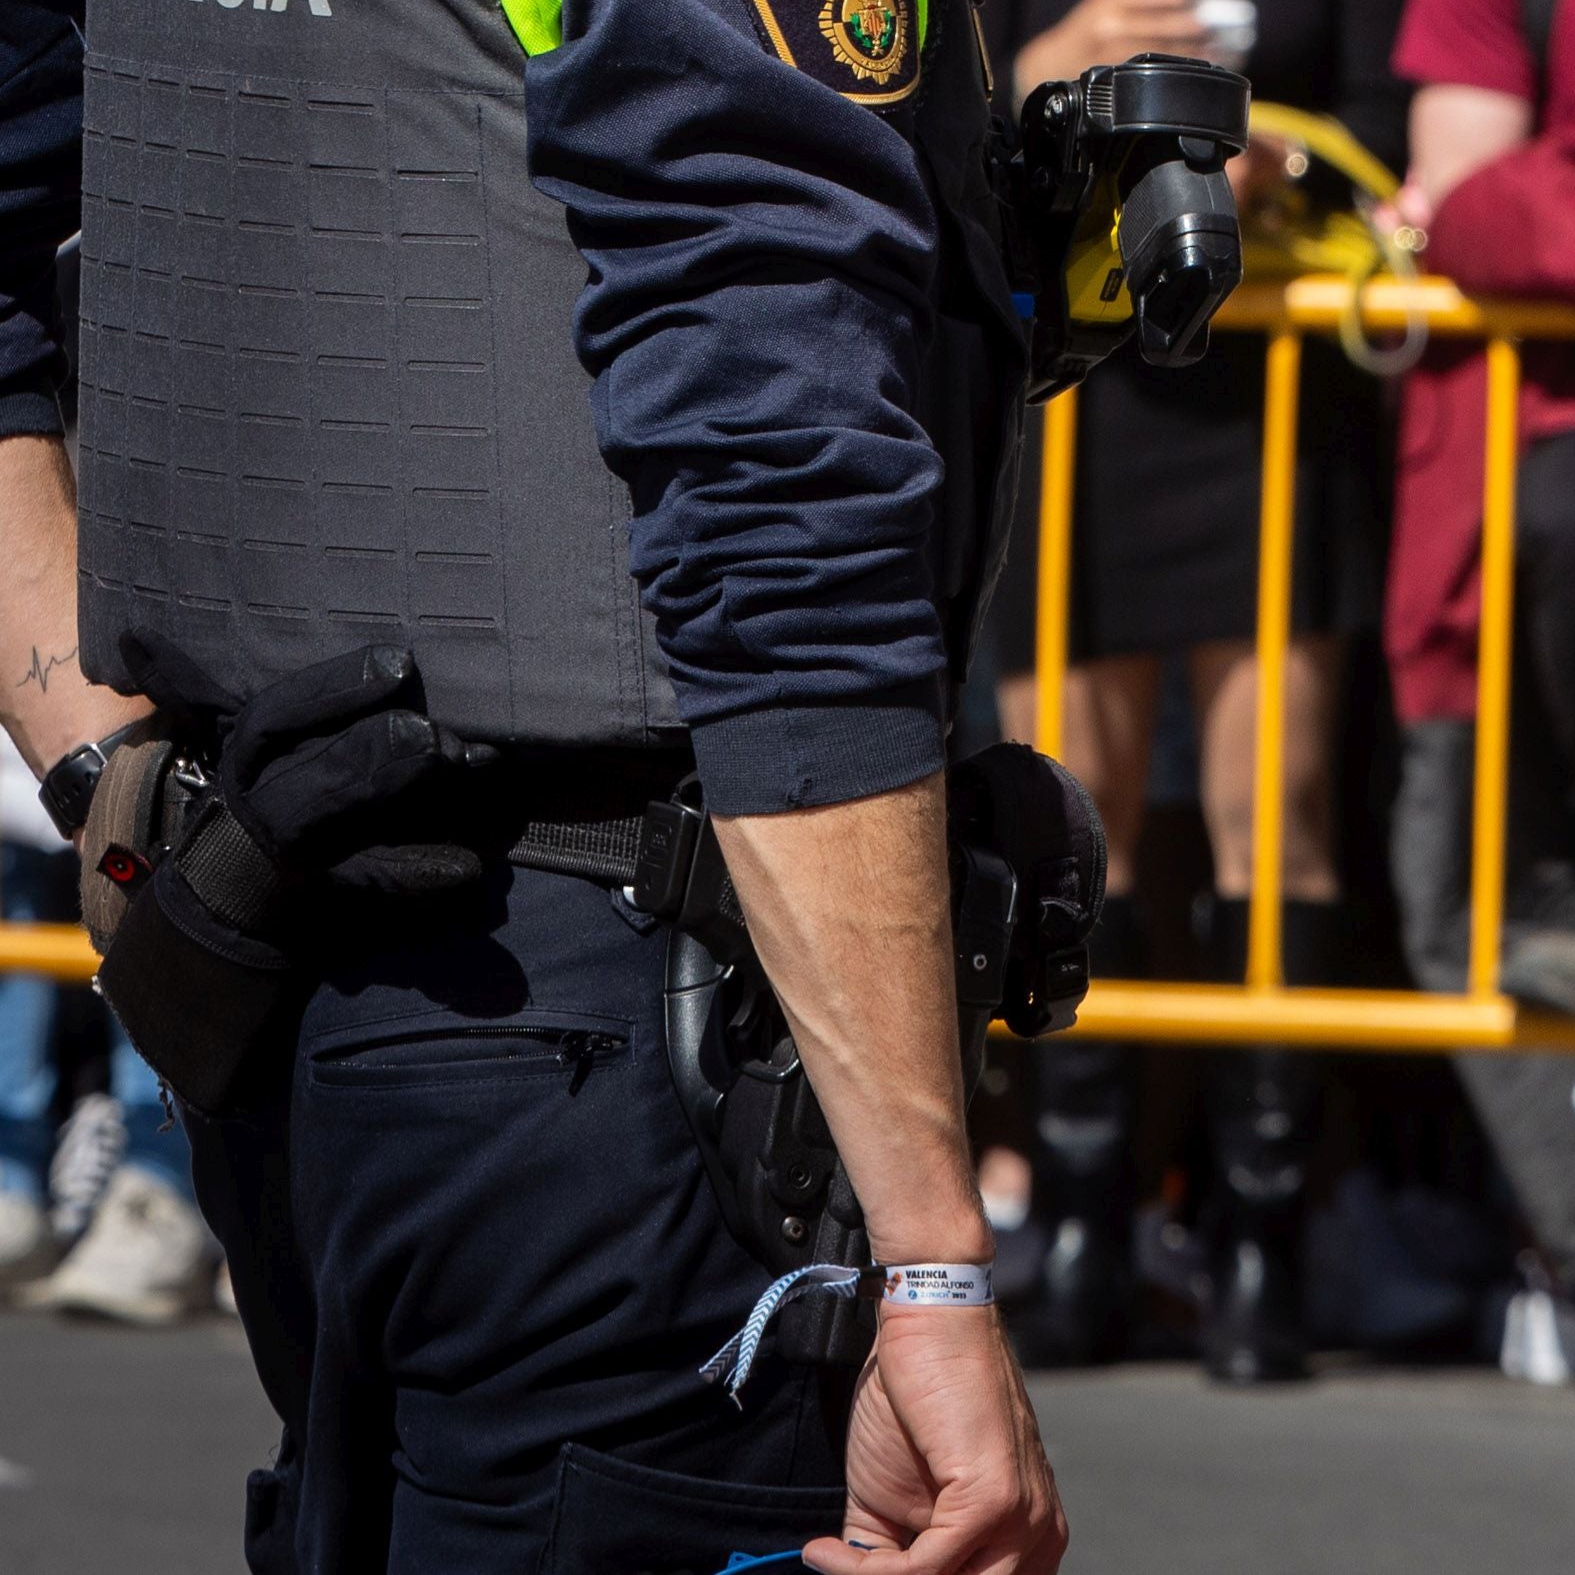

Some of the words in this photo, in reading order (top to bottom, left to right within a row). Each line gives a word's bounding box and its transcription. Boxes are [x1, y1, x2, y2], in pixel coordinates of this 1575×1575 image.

[905, 1270, 948, 1279] VALENCIA
[907, 1280, 940, 1288] TRINIDAD
[940, 1281, 974, 1290] ALFONSO
